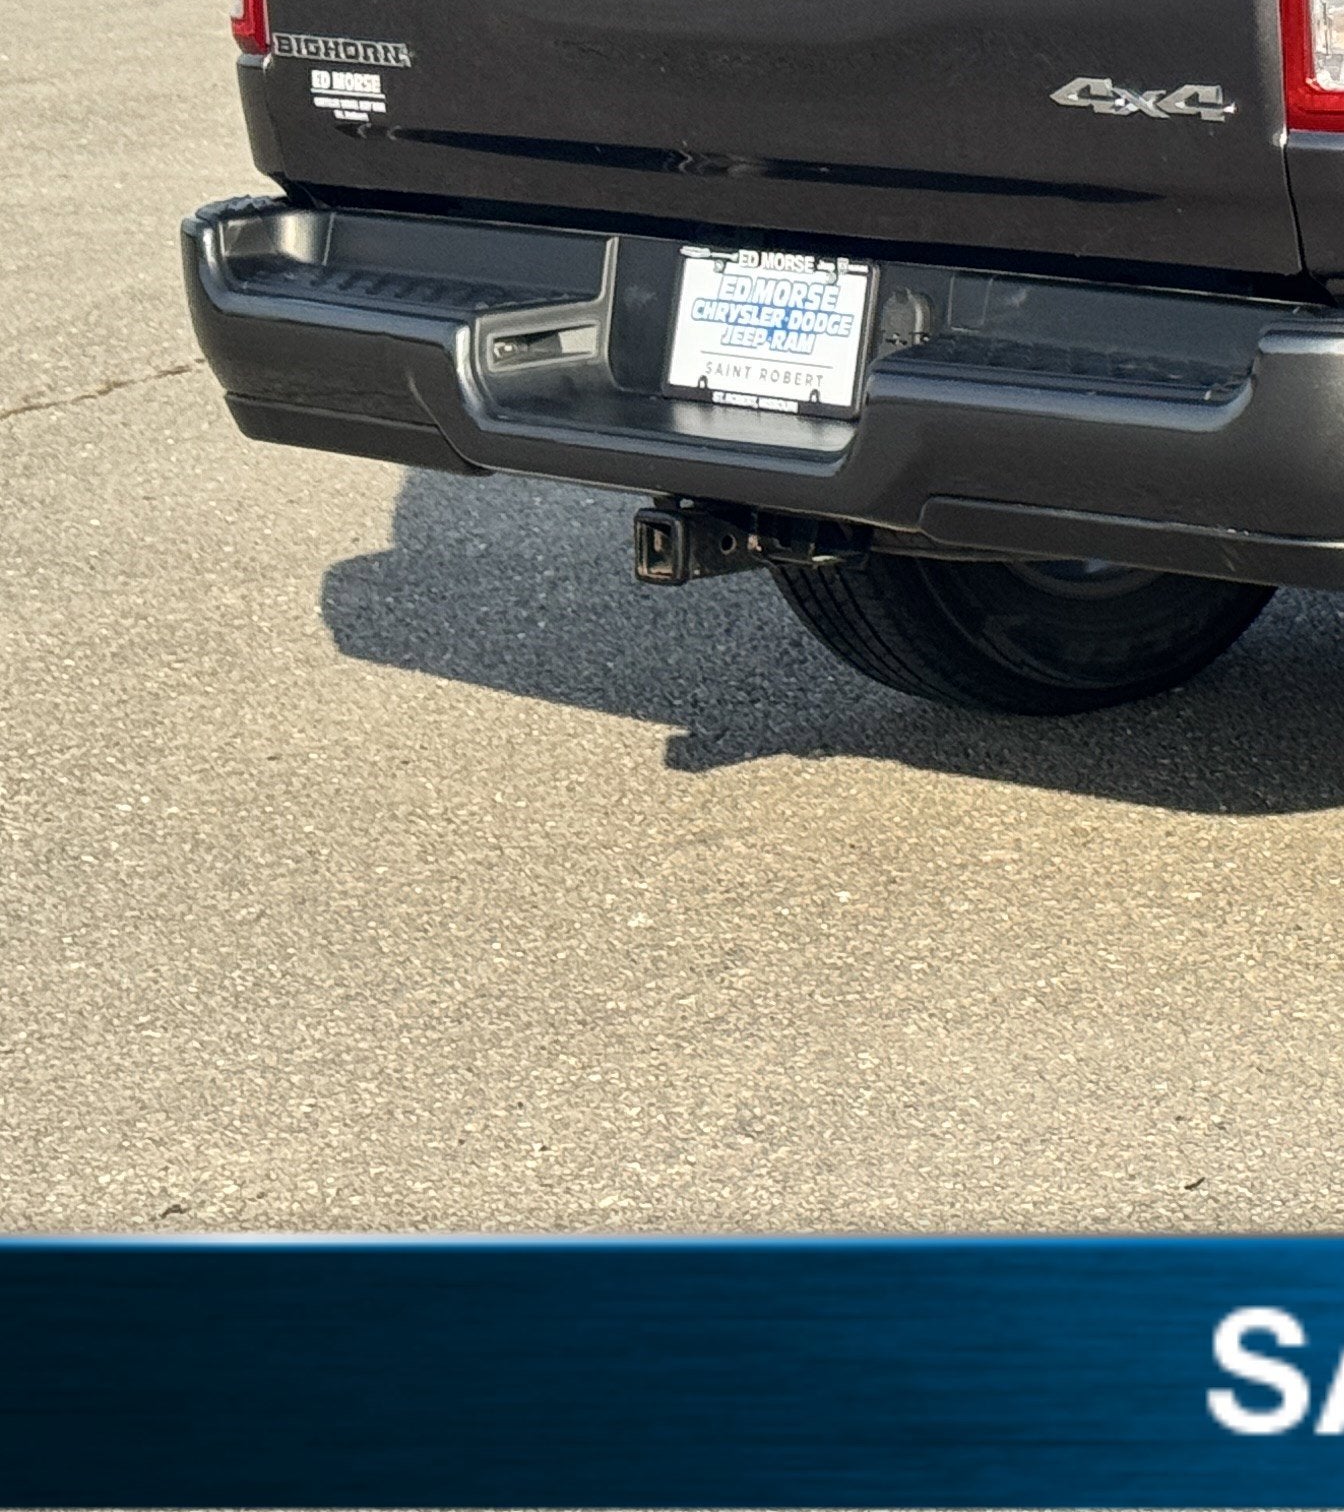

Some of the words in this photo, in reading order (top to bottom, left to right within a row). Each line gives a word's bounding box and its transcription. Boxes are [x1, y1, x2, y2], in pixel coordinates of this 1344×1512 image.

[273, 33, 410, 67] BIGHORN
[311, 69, 331, 89] ED
[332, 71, 380, 94] MORSE
[738, 249, 759, 268] ED
[761, 251, 815, 274] MORSE
[718, 275, 753, 303] ED
[752, 277, 840, 311] MORSE
[705, 361, 752, 379] SAINT
[760, 368, 824, 387] ROBERT
